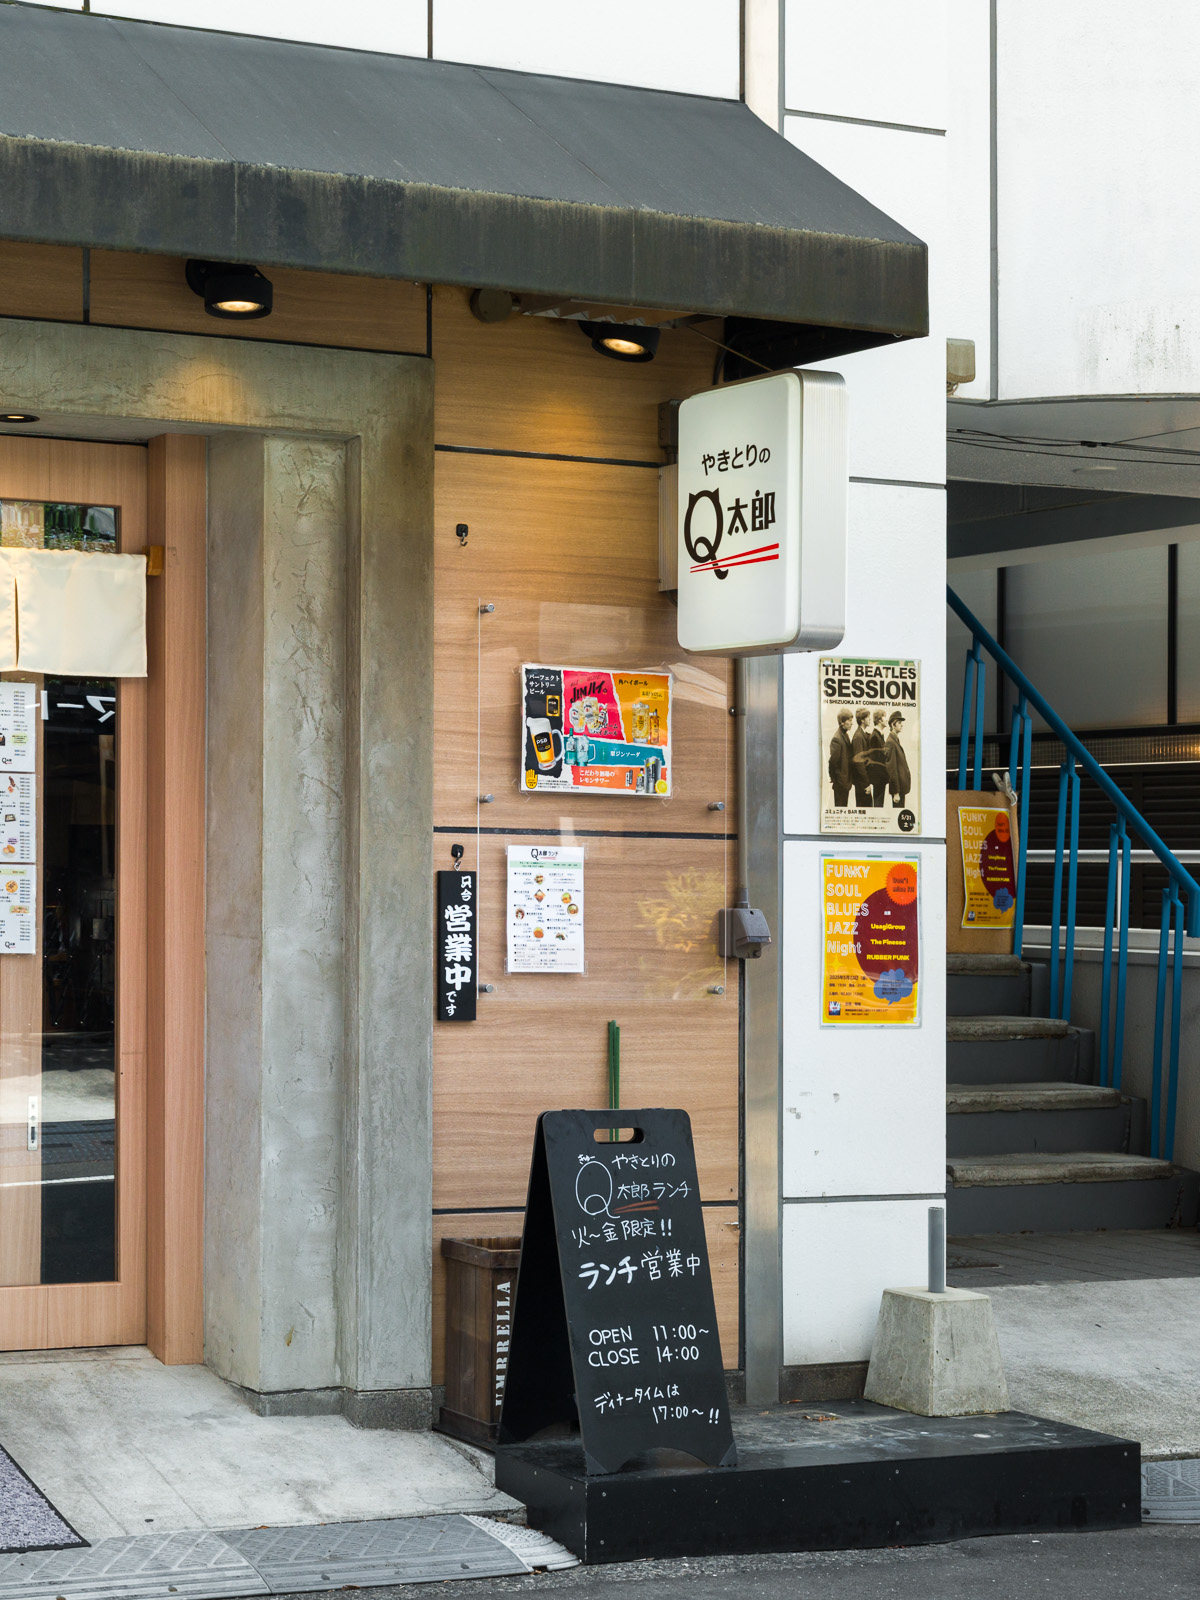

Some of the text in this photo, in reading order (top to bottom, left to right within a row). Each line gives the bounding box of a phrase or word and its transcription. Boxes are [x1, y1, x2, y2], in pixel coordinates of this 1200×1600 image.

[701, 444, 771, 476] やきとりの
[684, 487, 776, 580] Q太郎
[528, 674, 560, 682] パーフェクト
[822, 663, 917, 680] THE BEATLES
[823, 678, 916, 701] SESSION
[962, 812, 987, 823] FUNKY
[963, 826, 983, 836] SOUL
[963, 840, 988, 850] BLUES
[965, 854, 982, 864] JAZZ
[826, 864, 871, 878] FUNKY
[966, 868, 984, 879] Night
[826, 883, 862, 897] SOUL
[826, 902, 869, 917] BLUES
[826, 921, 859, 935] JAZZ
[870, 923, 905, 931] UsagiGroup
[826, 940, 862, 956] Night
[611, 1152, 676, 1170] やきとりの
[578, 1248, 701, 1290] ランチ営業中
[588, 1325, 633, 1346] OPEN
[588, 1345, 700, 1368] CLOSE 14:00
[594, 1383, 680, 1414] ディナータイムは
